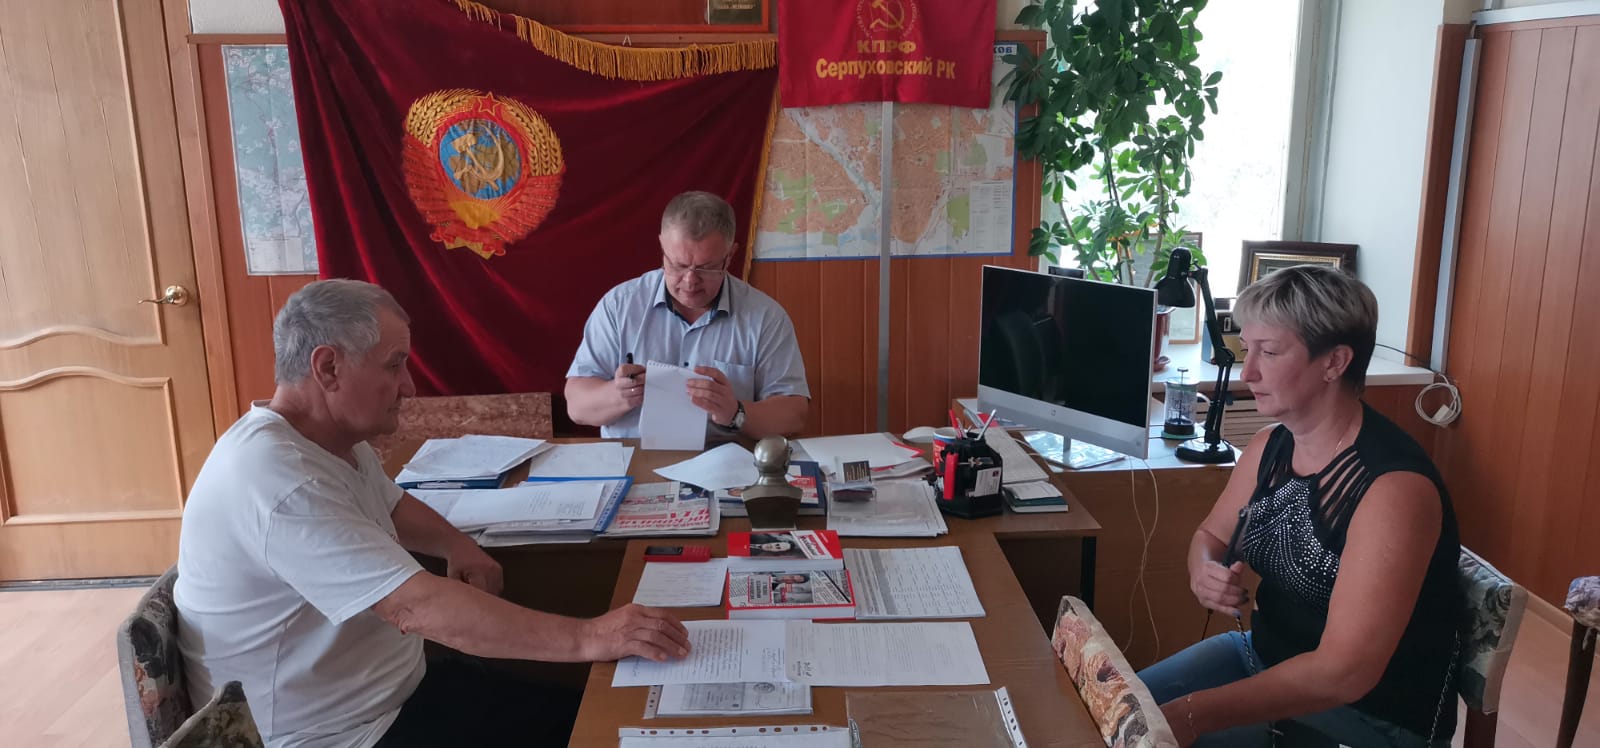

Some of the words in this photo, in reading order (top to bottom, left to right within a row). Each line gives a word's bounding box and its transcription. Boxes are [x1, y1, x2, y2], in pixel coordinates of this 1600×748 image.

[857, 40, 917, 53] КПРФ
[815, 56, 932, 80] Серпуховский
[936, 60, 956, 79] РК
